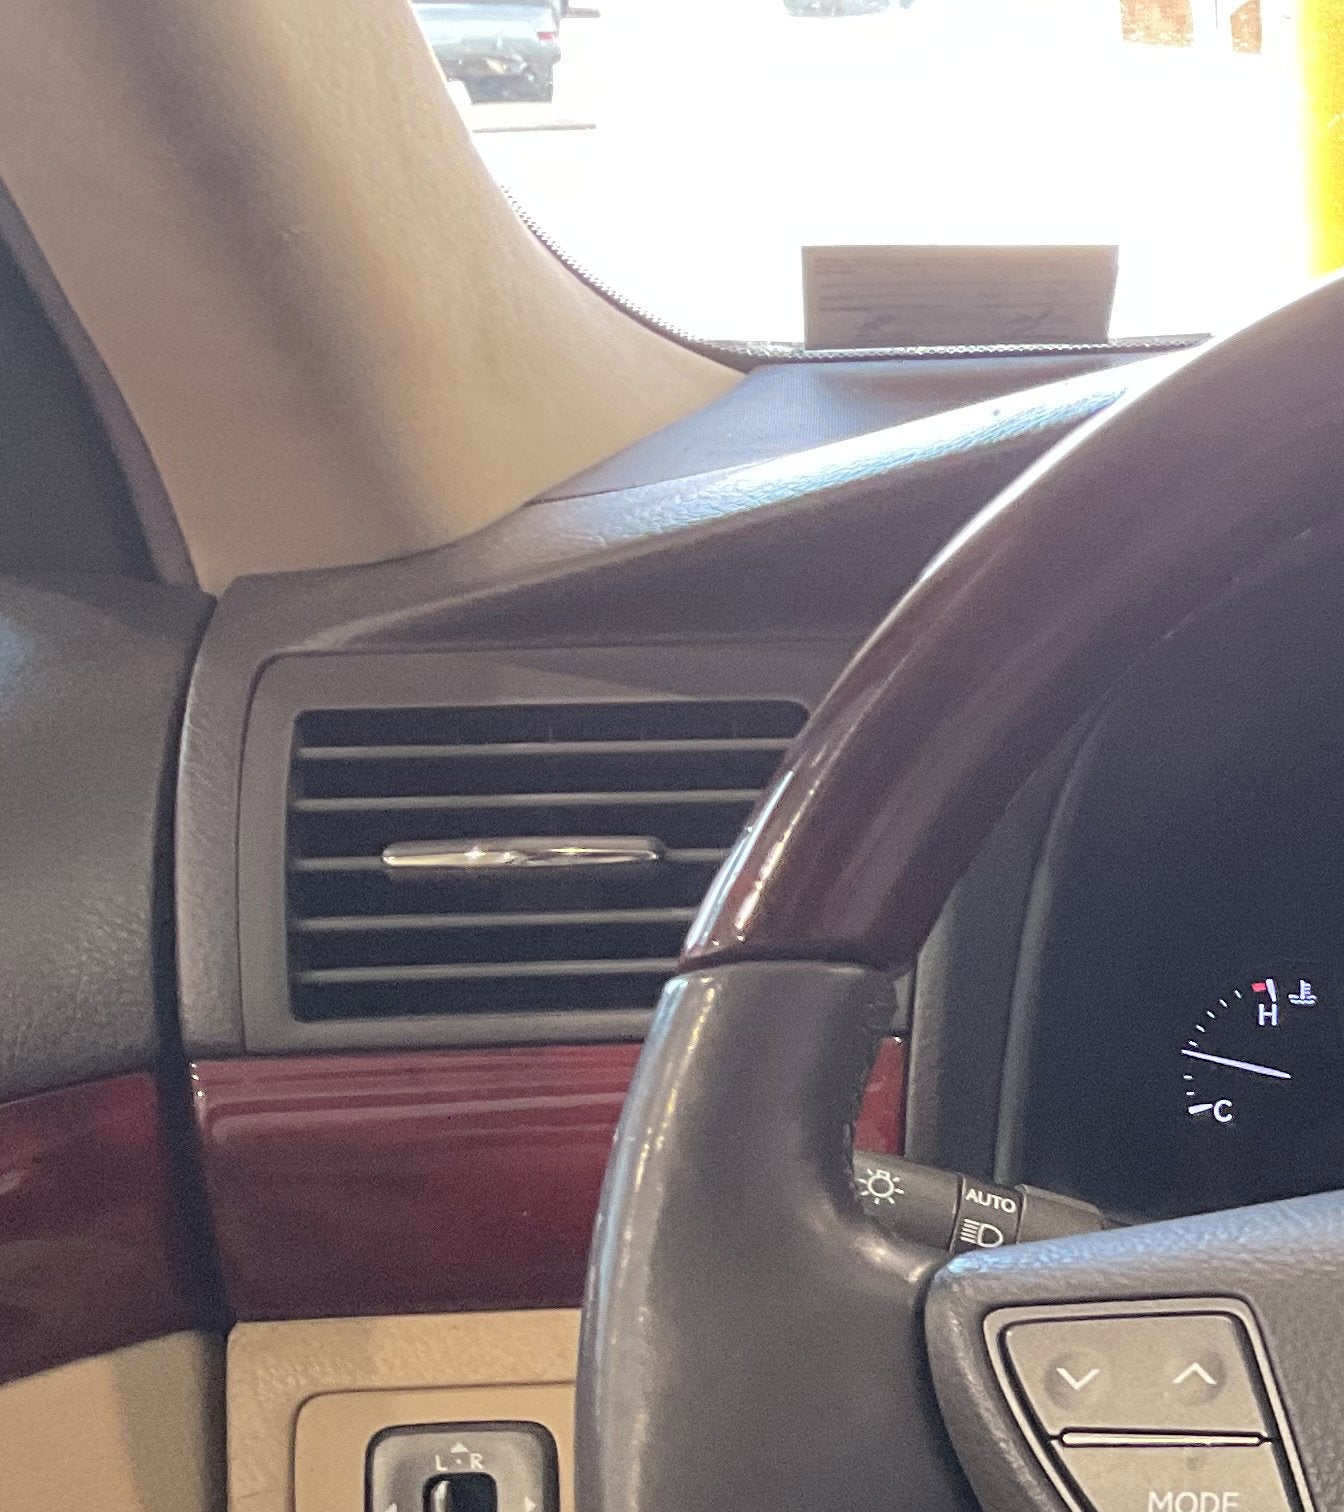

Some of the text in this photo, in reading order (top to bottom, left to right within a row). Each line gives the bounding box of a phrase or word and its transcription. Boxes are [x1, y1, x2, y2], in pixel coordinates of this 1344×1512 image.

[1258, 1004, 1279, 1026] H
[1213, 1100, 1234, 1124] C
[965, 1187, 1017, 1215] AUTO
[434, 1452, 485, 1472] L R
